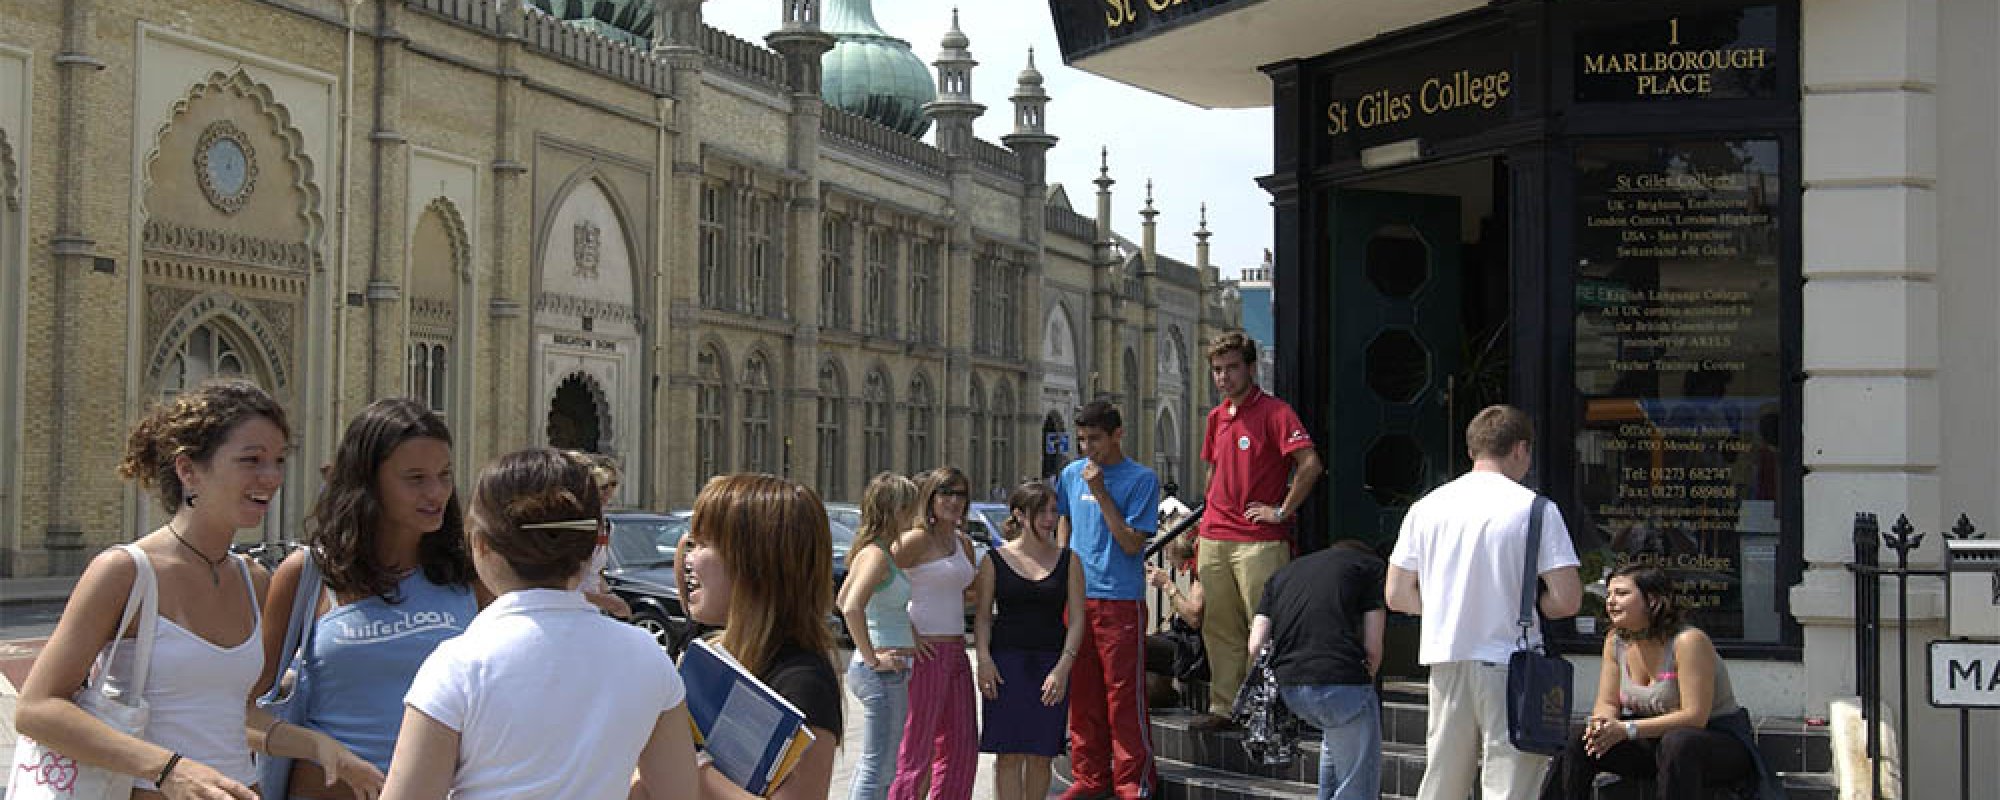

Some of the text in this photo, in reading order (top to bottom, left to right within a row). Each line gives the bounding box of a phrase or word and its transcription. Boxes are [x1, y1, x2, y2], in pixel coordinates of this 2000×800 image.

[1105, 0, 1137, 27] St
[1669, 18, 1680, 45] 1
[1584, 48, 1765, 74] MARLBOROUGH
[1637, 73, 1712, 95] PLACE
[1327, 69, 1511, 136] St Giles College
[1615, 173, 1632, 189] St
[1636, 173, 1674, 189] Giles
[1607, 200, 1625, 211] UK
[1587, 215, 1627, 227] London
[1675, 215, 1717, 227] London
[1621, 231, 1648, 241] USA
[1658, 231, 1680, 241] San
[1622, 307, 1641, 317] UK
[1653, 361, 1700, 374] Training
[1620, 423, 1651, 436] Office
[1663, 440, 1706, 453] Monday
[1717, 440, 1753, 454] Friday
[1622, 468, 1650, 480] Tel:
[1651, 468, 1684, 480] 01273
[1619, 485, 1650, 498] Fax:
[1651, 485, 1685, 498] 01273
[1677, 553, 1730, 572] College
